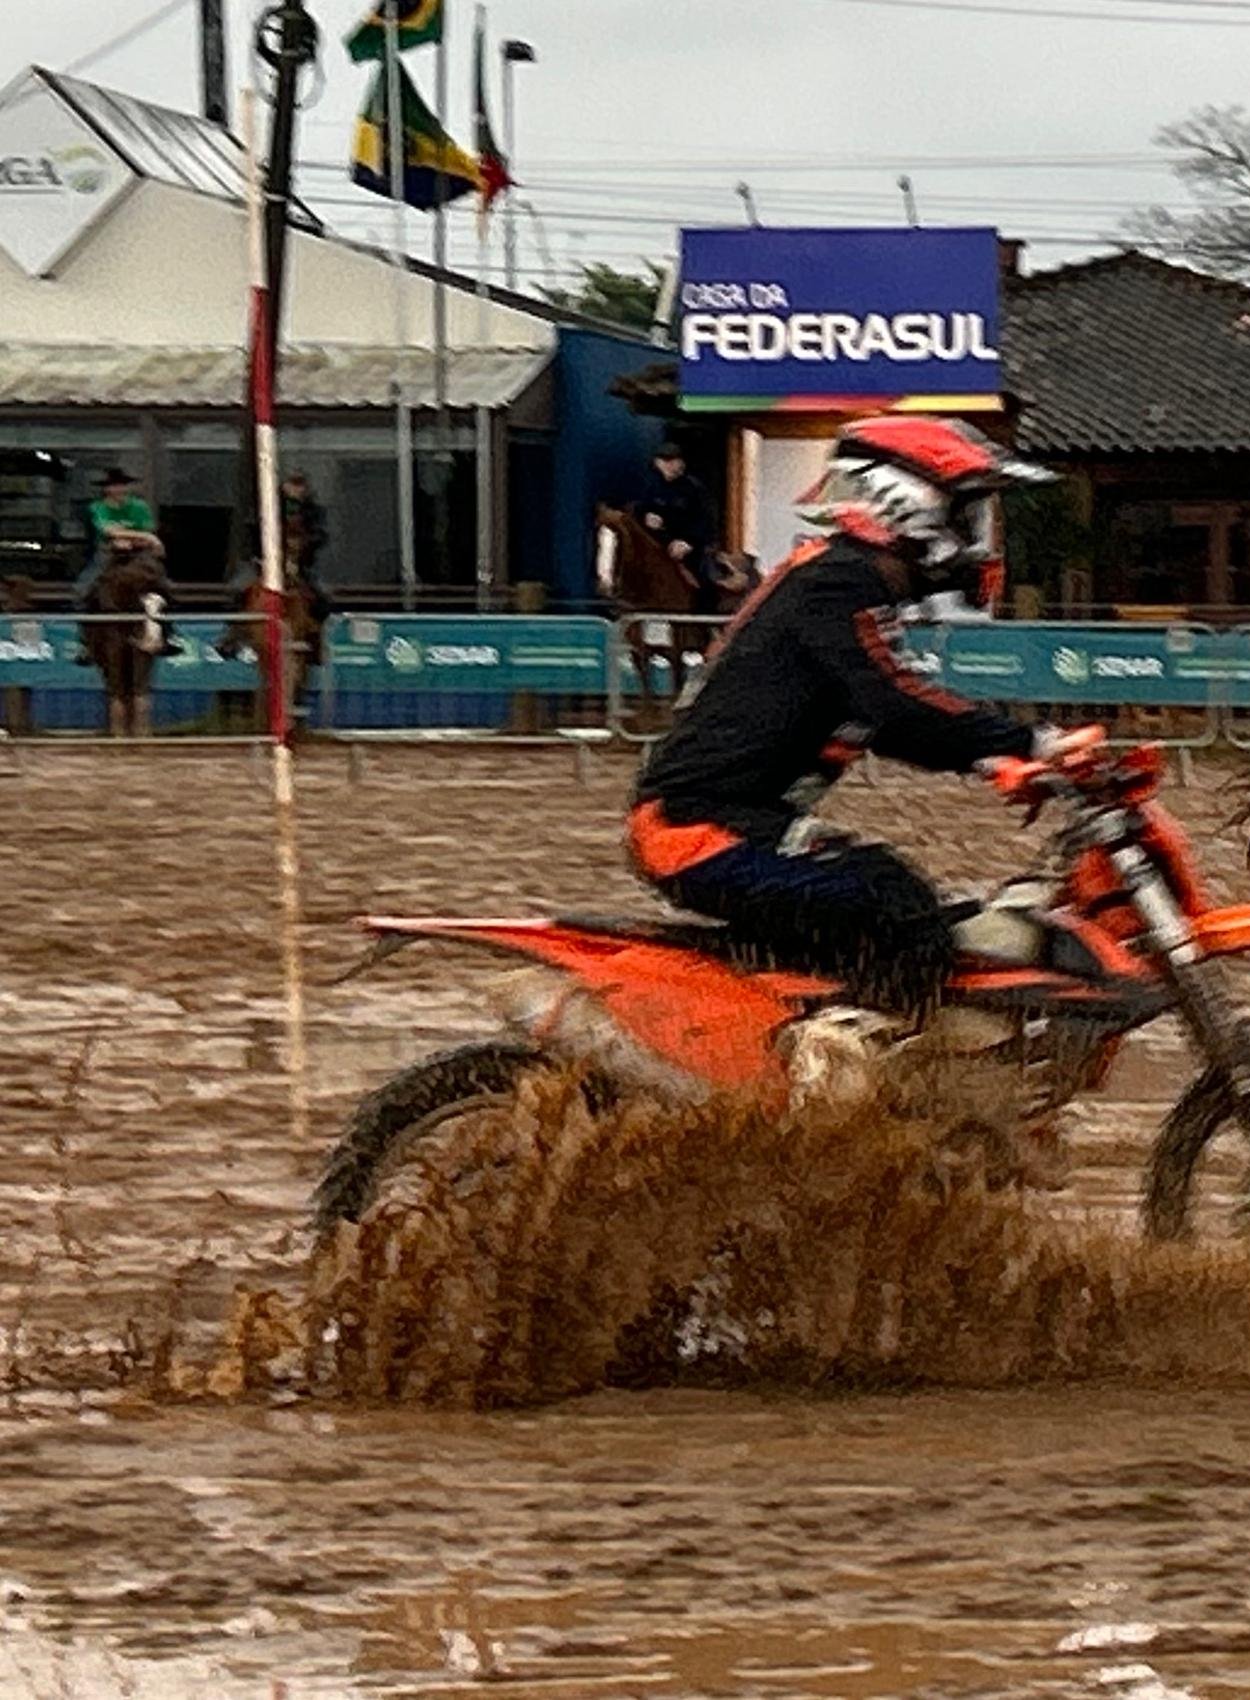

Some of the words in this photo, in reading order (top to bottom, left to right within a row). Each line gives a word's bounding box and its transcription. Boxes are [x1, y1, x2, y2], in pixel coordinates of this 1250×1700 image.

[682, 283, 748, 309] CASA
[750, 283, 788, 308] DA
[682, 312, 998, 360] FEDERASUL
